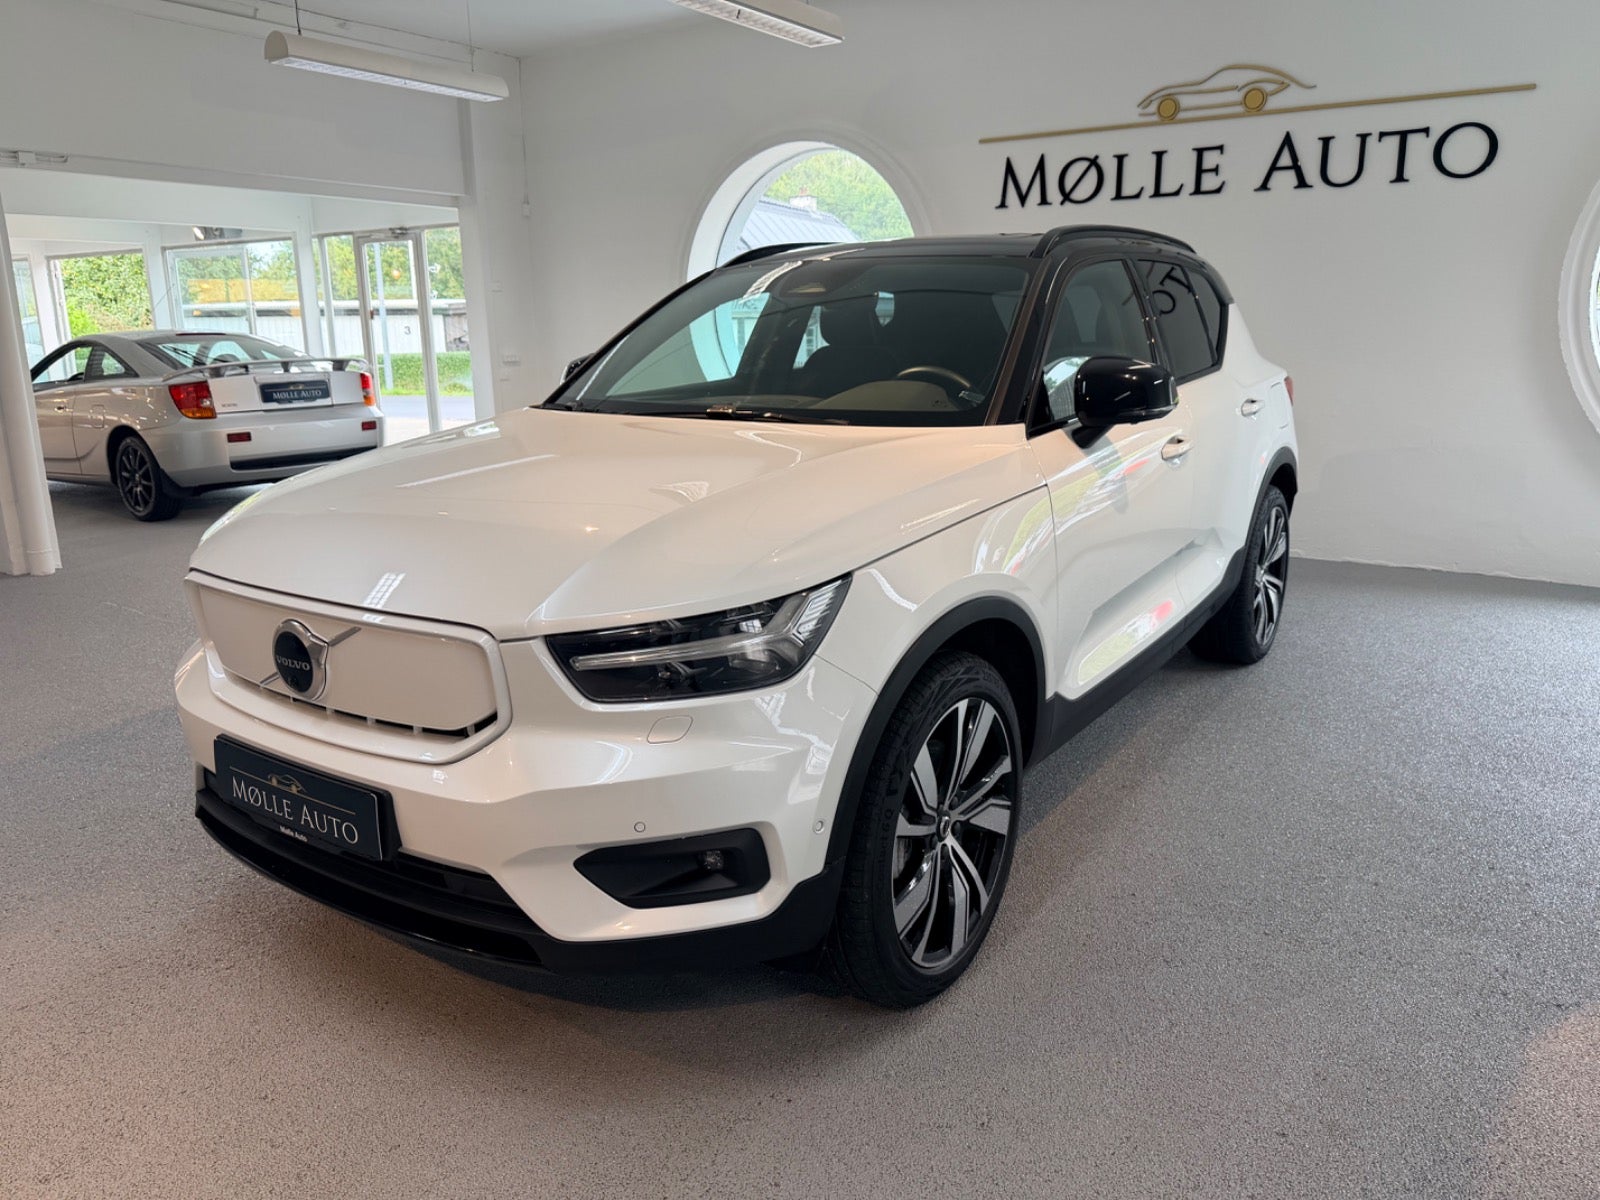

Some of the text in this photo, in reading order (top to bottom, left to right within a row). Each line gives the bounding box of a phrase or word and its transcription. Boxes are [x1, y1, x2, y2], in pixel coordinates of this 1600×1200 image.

[995, 122, 1499, 210] MØLLE AUTO
[272, 389, 322, 400] MØLLE AUTO
[276, 655, 310, 671] VOLVO
[232, 775, 358, 844] MØLLE AUTO
